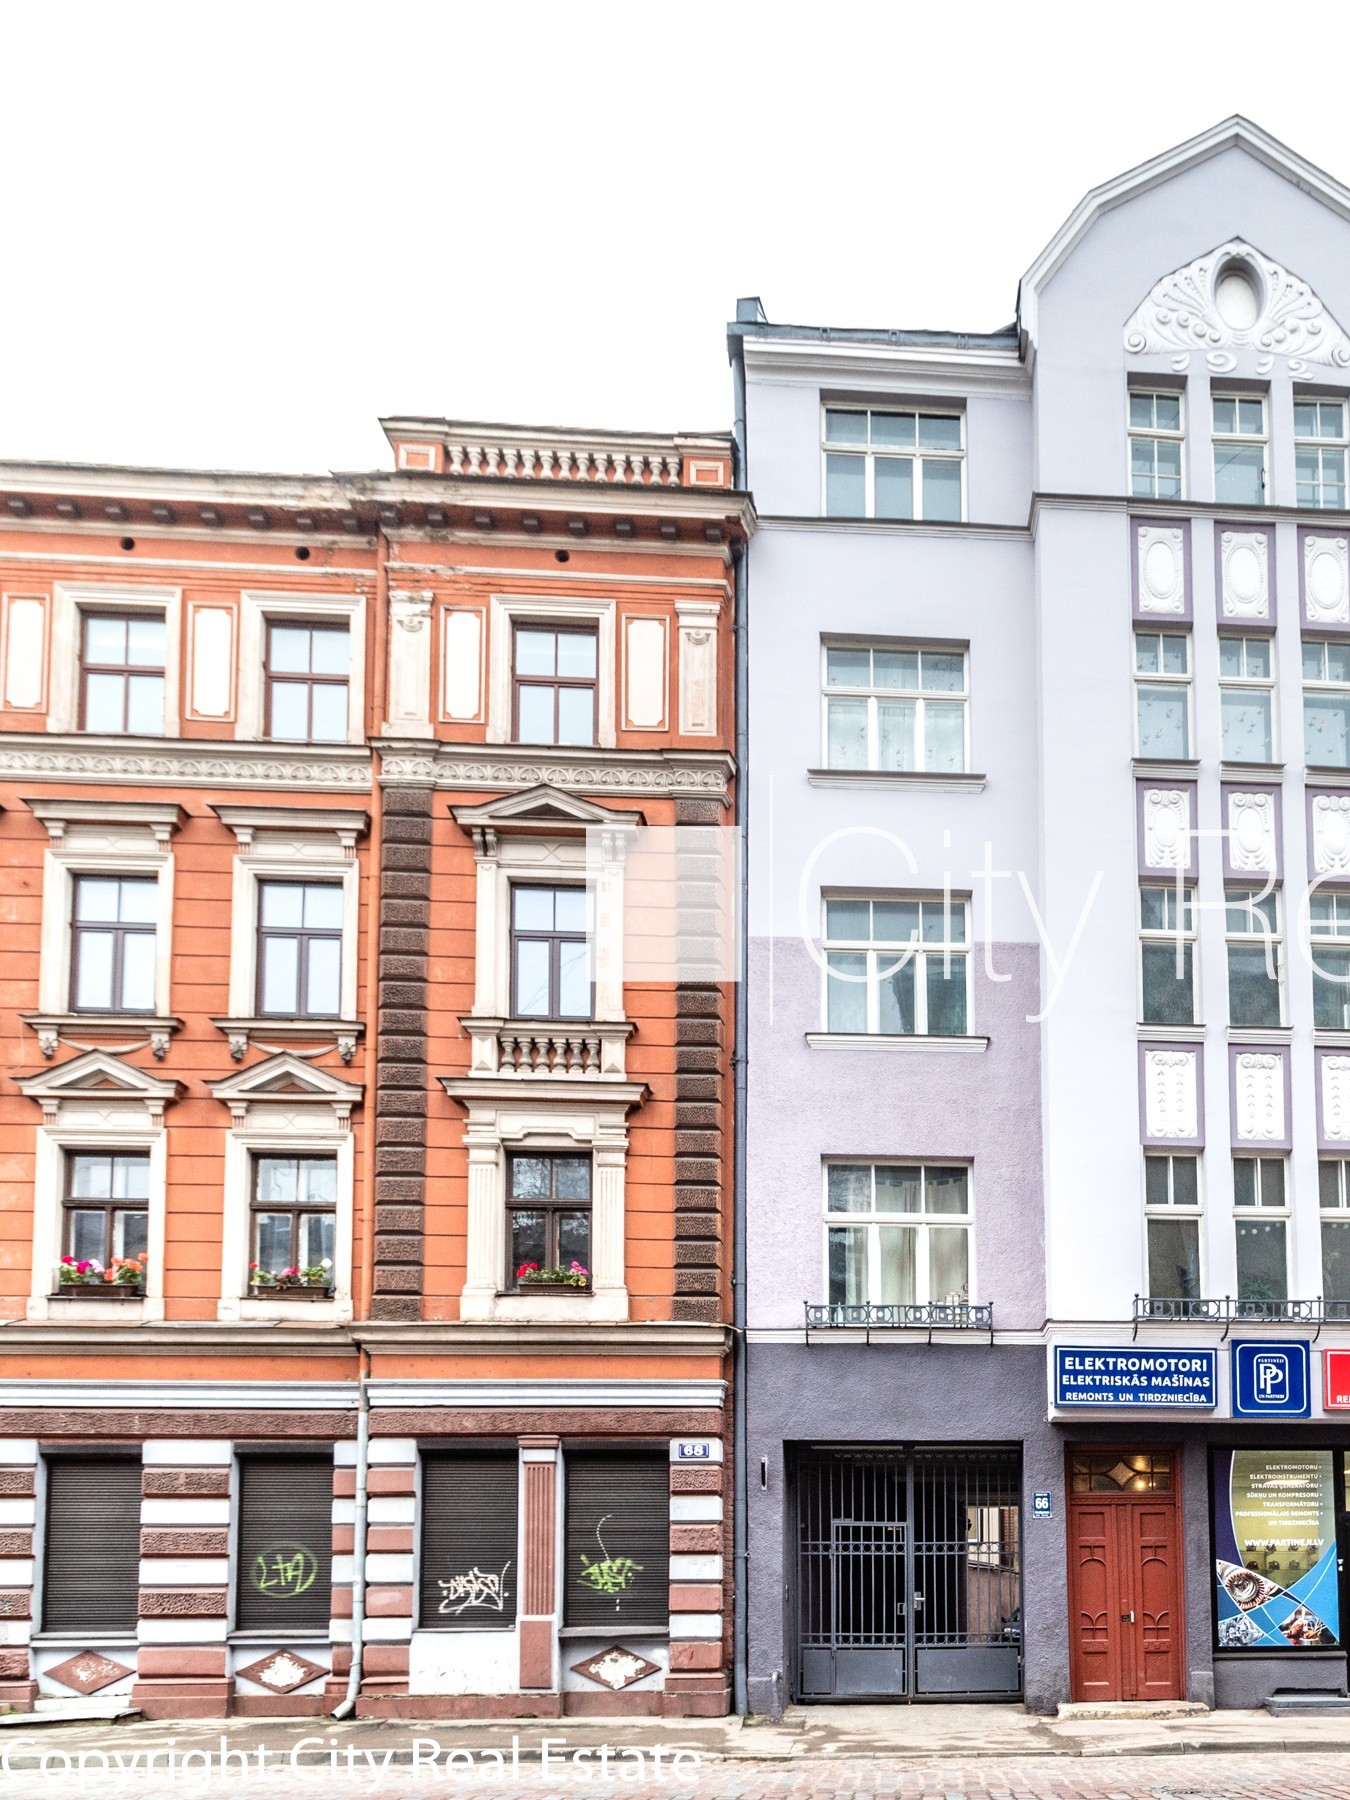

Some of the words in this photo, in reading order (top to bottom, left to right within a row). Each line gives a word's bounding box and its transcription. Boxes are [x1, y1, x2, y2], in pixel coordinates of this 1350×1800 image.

[1064, 1357, 1207, 1372] ELEKTROMOTORI
[1062, 1374, 1148, 1386] ELEKTRISKĀS
[1152, 1374, 1210, 1388] MAŠĪNAS
[1066, 1392, 1114, 1401] REMONTS
[1118, 1393, 1134, 1402] UN
[1138, 1392, 1207, 1402] TIRDZNIECĪBA
[684, 1445, 704, 1456] 68
[1035, 1498, 1048, 1509] 66
